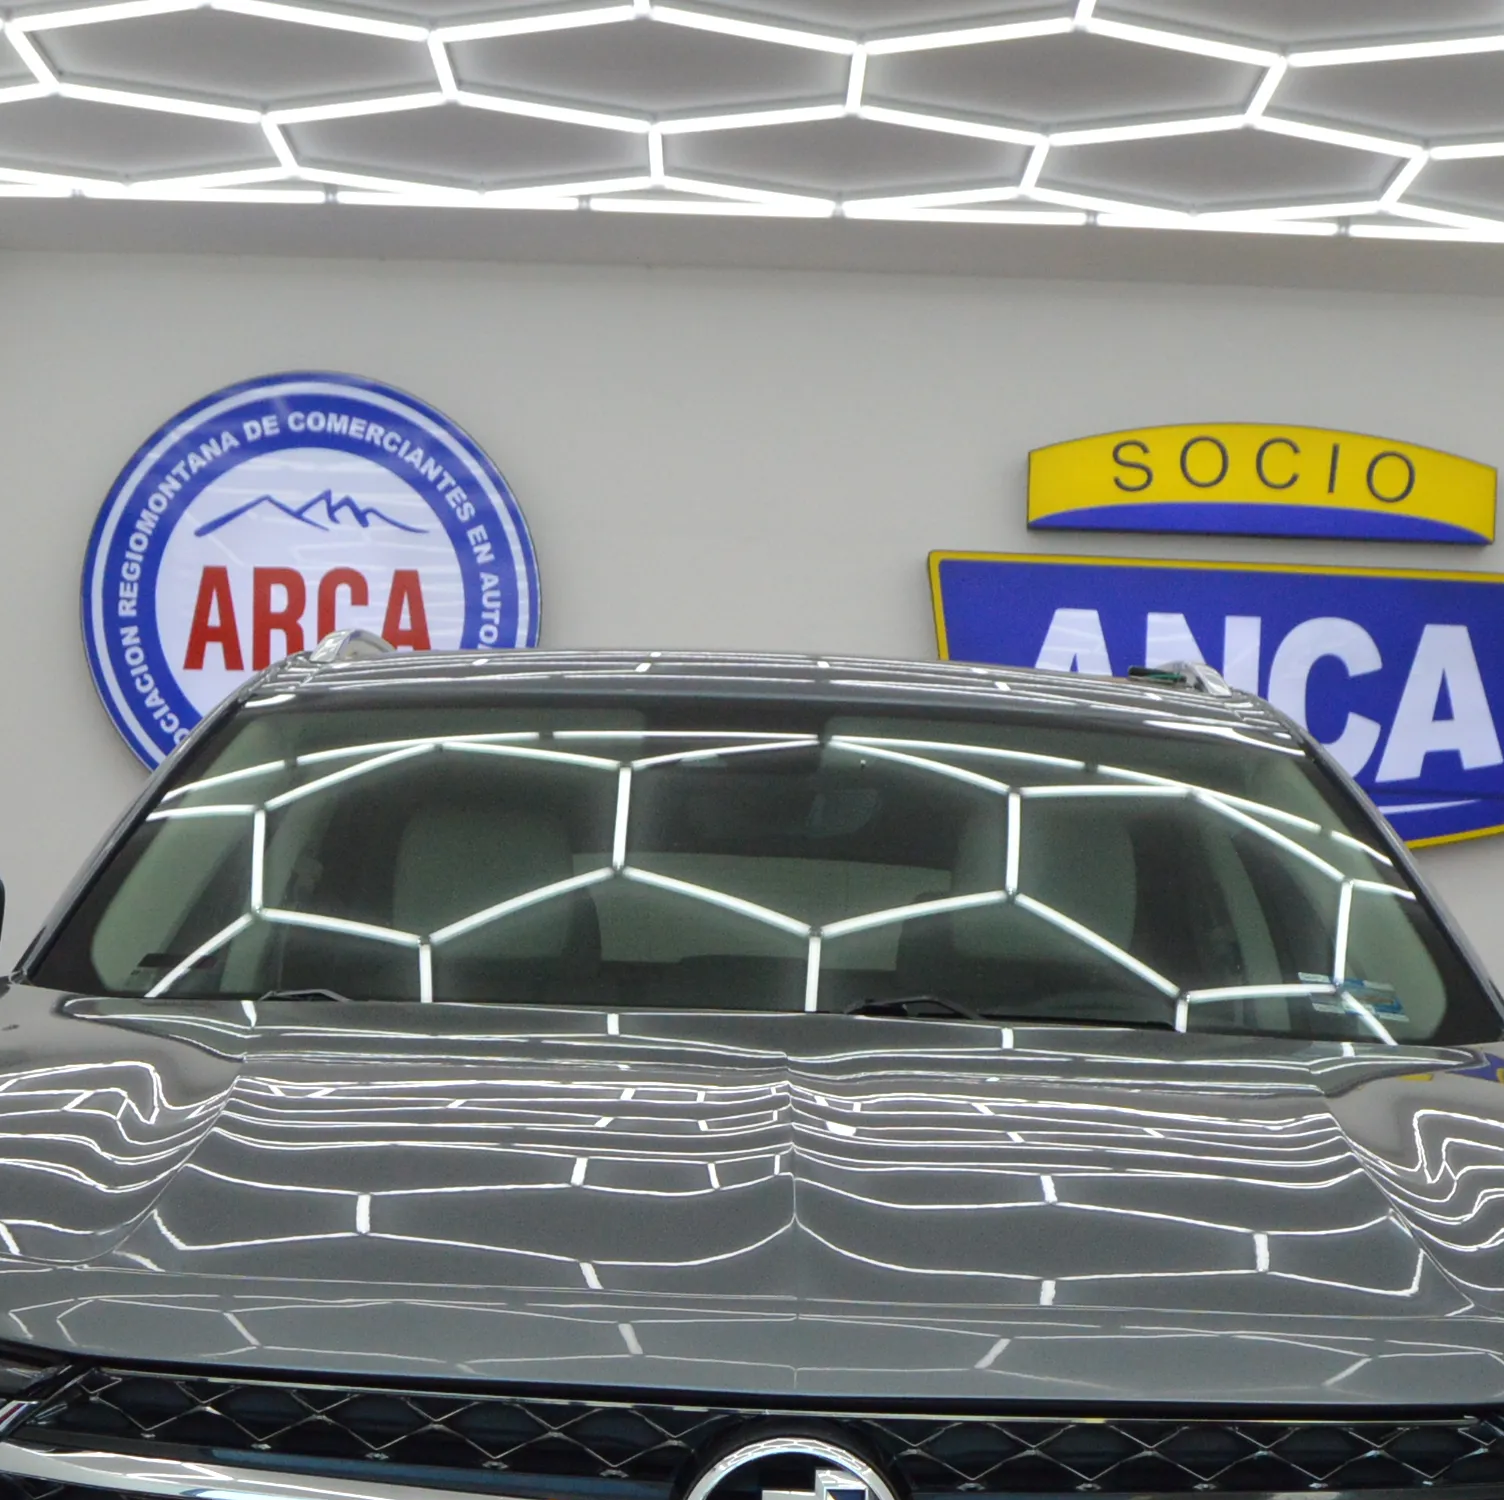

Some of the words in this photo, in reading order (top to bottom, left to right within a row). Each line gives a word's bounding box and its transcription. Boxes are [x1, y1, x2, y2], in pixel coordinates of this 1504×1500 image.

[243, 415, 281, 443] DE
[287, 411, 477, 523] COMERCIANTES
[1112, 436, 1416, 504] SOCIO
[118, 430, 240, 618] REGIOMONTANA
[466, 524, 496, 565] EN
[182, 565, 433, 673] ARCA
[477, 571, 502, 650] AUTO
